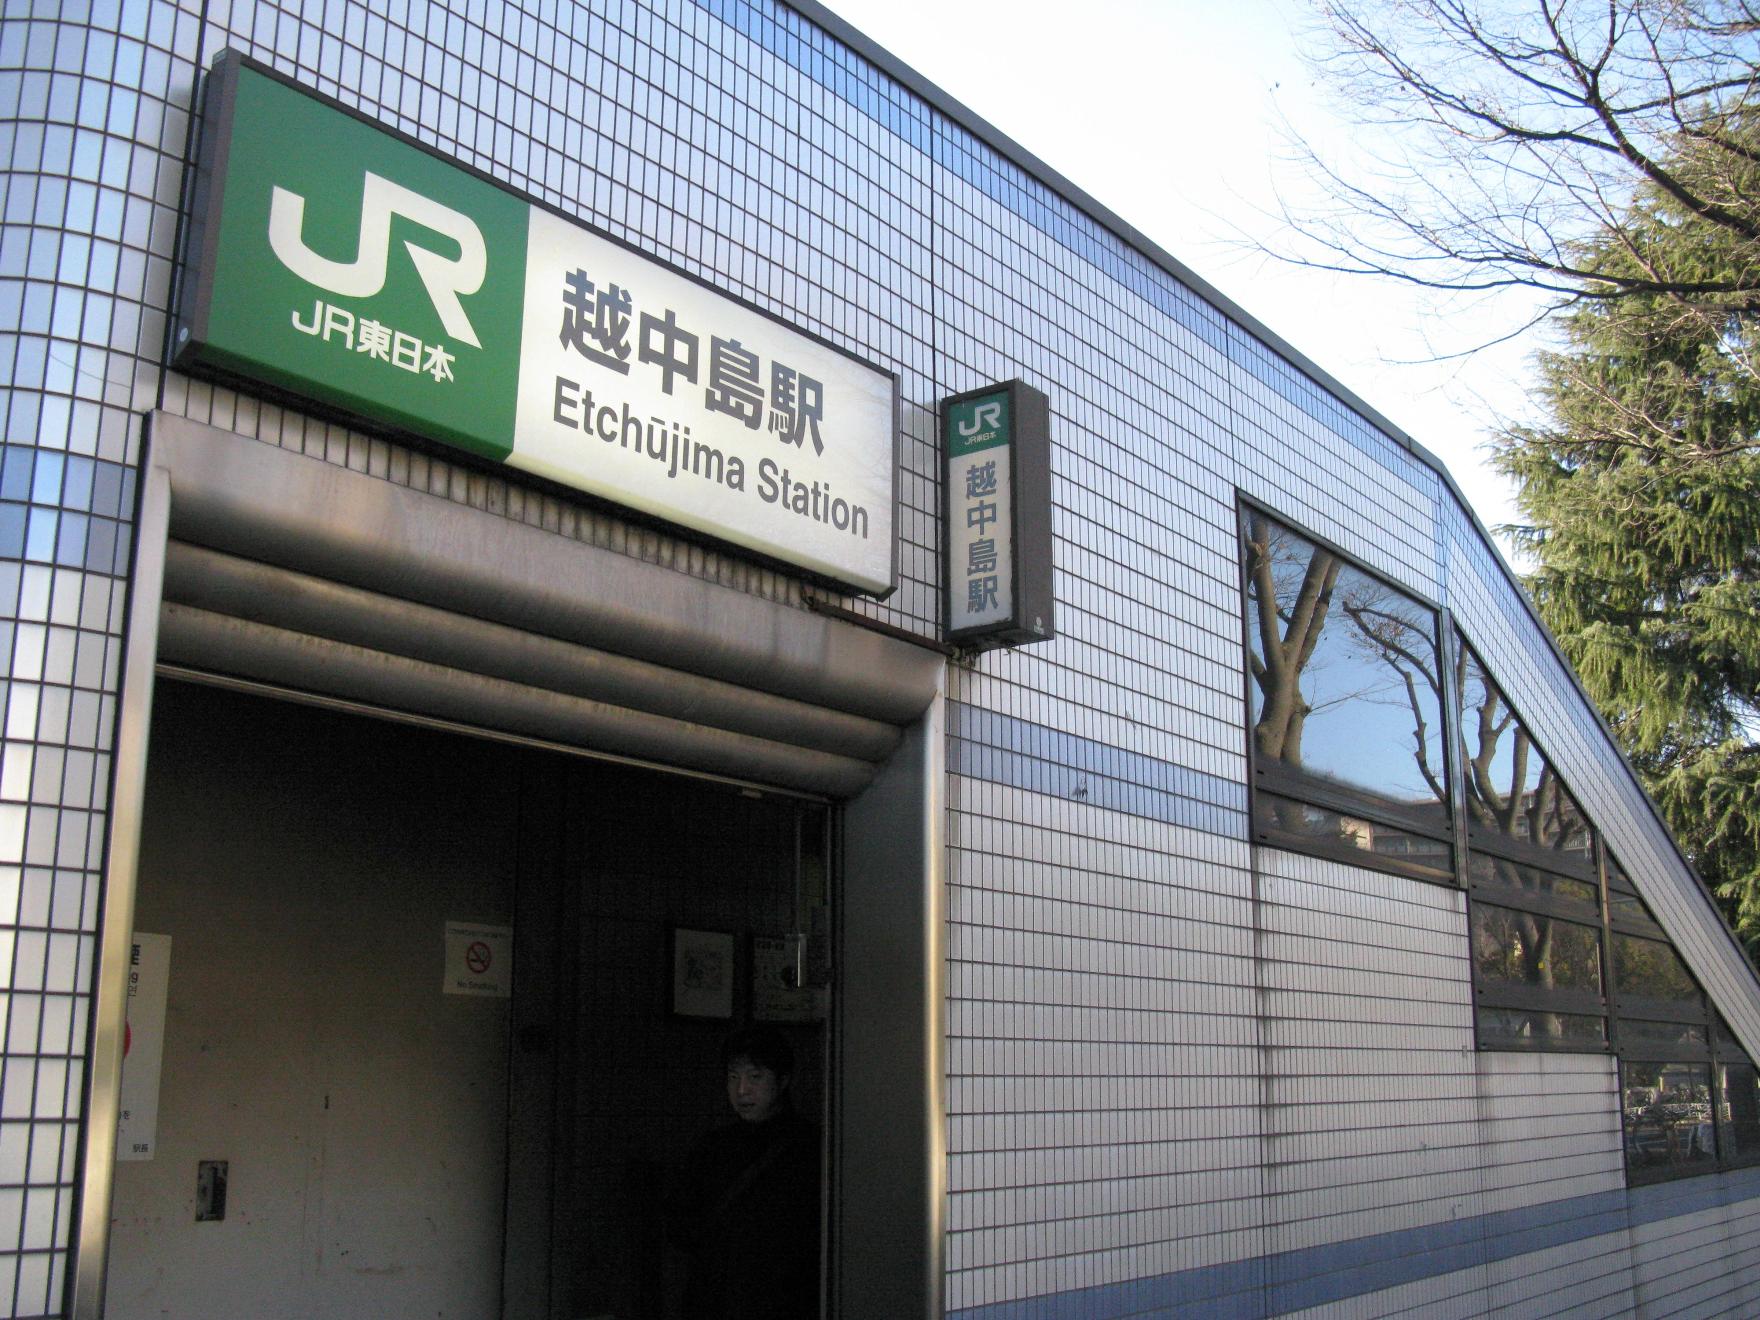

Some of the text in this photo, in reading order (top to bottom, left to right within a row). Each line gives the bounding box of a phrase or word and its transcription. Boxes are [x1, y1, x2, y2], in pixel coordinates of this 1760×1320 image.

[269, 170, 487, 350] JR
[292, 300, 455, 383] JR東日本
[559, 268, 824, 456] 越中島駅
[958, 402, 1001, 437] JR
[553, 375, 868, 539] Etchūjima Station
[965, 460, 998, 613] 越中島駅
